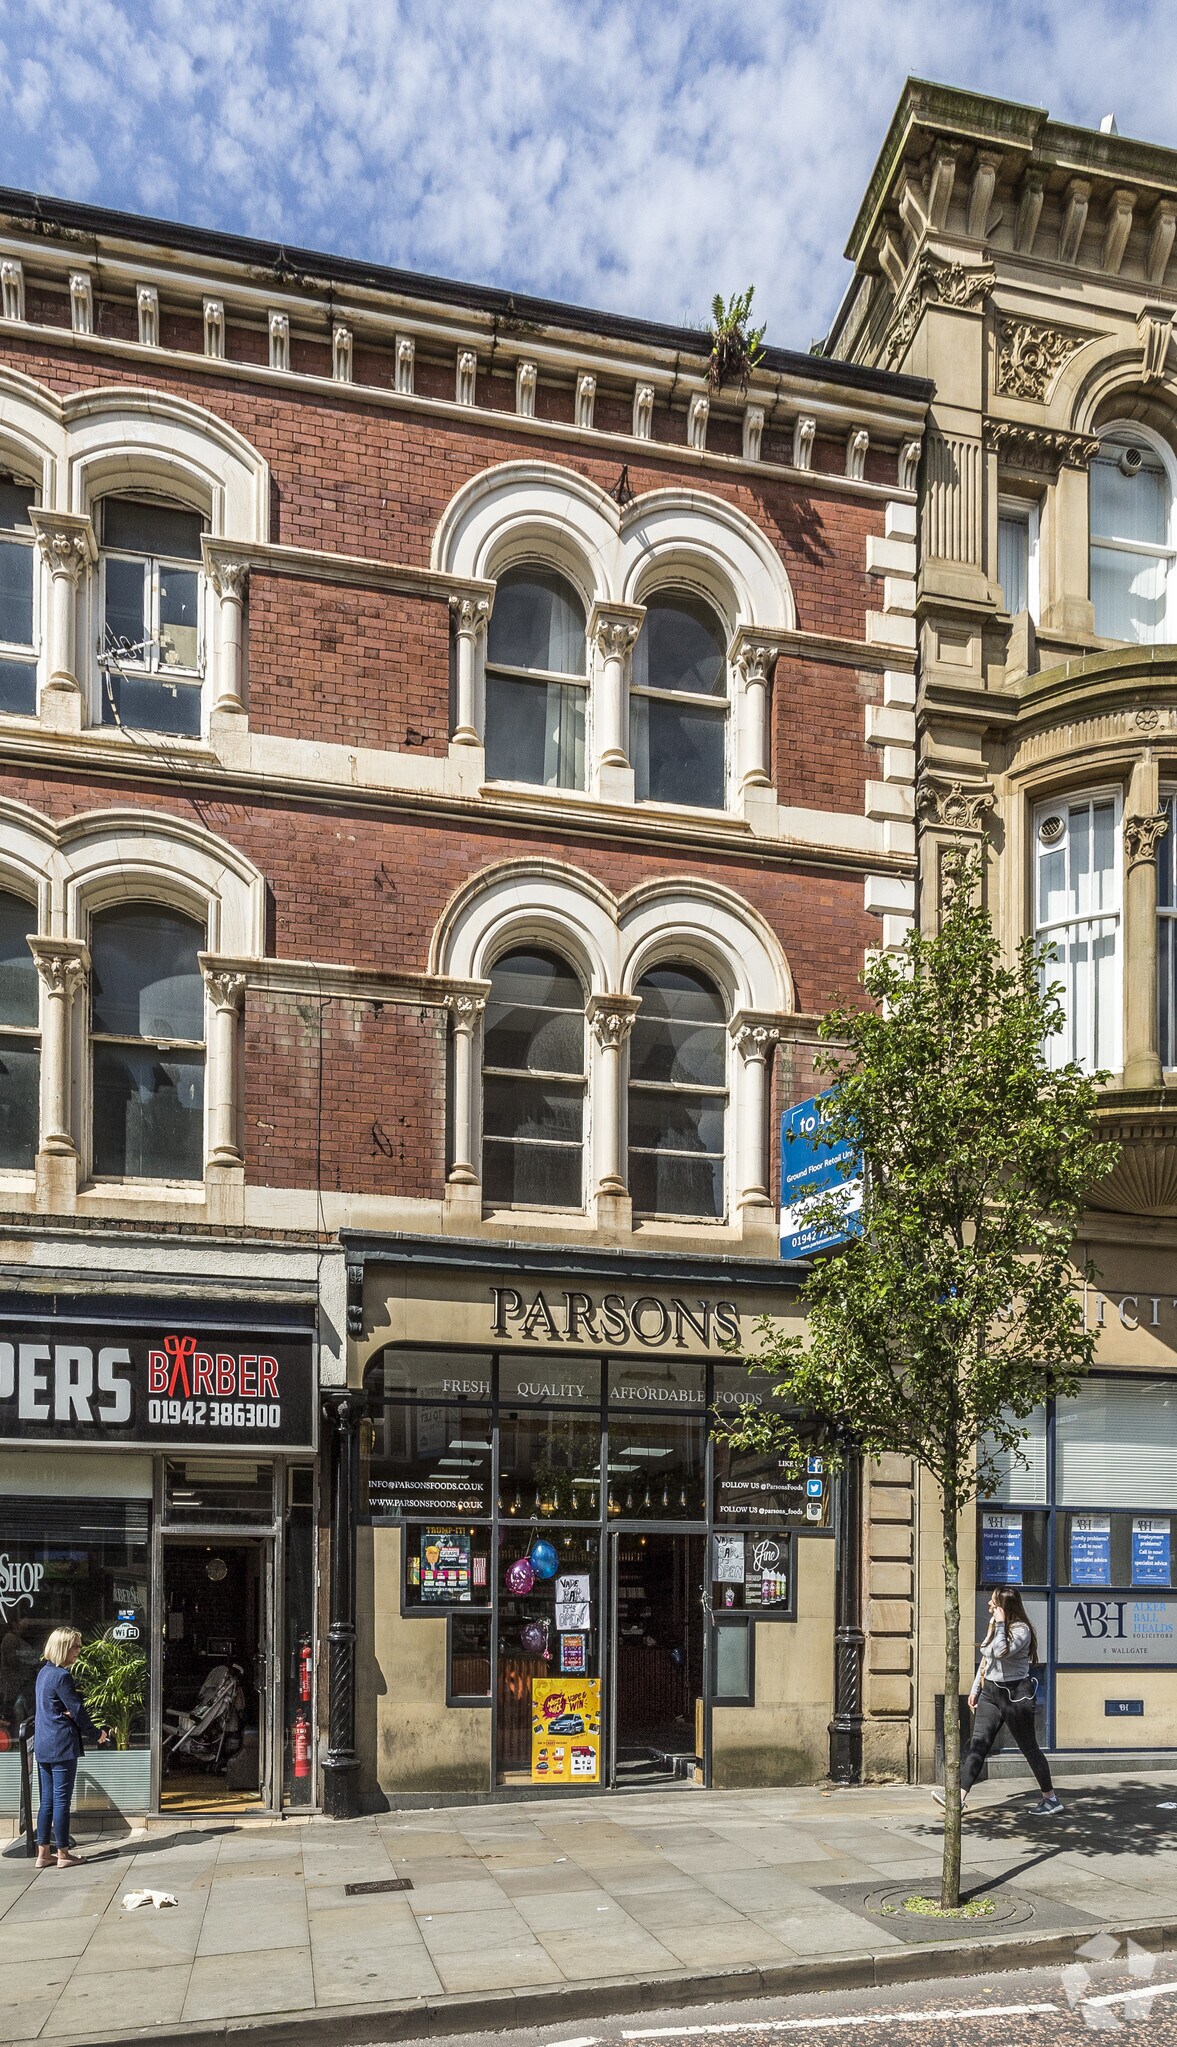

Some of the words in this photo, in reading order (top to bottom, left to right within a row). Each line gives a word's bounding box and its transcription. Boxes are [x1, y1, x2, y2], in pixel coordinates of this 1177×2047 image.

[800, 1116, 815, 1132] to
[786, 1167, 808, 1183] Ground
[808, 1162, 824, 1174] Floor
[824, 1155, 842, 1168] Retail
[842, 1148, 855, 1160] Uni
[791, 1230, 817, 1248] 01942
[488, 1286, 741, 1349] PARSONS
[148, 1336, 280, 1398] BARBER
[441, 1378, 491, 1394] FRESH
[517, 1382, 585, 1397] QUALITY
[609, 1386, 706, 1403] AFFORDABLE
[716, 1391, 763, 1406] FOODS
[148, 1400, 209, 1426] 01942
[209, 1402, 281, 1428] 386300
[368, 1480, 484, 1491] INFO@PARSONSFOODS.CO.UK
[760, 1483, 804, 1491] @ParsonsFoods
[369, 1498, 483, 1509] WWW.PARSONSFOODS.CO.UK
[720, 1505, 748, 1513] FOLLOW
[758, 1507, 803, 1515] @parsons_foods
[425, 1526, 466, 1534] TRUMP-IT!
[1133, 1602, 1167, 1611] ALKER
[1074, 1601, 1128, 1639] ABH
[1133, 1612, 1159, 1622] BALL
[1133, 1623, 1174, 1633] HEALDS
[570, 1700, 584, 1711] WIN
